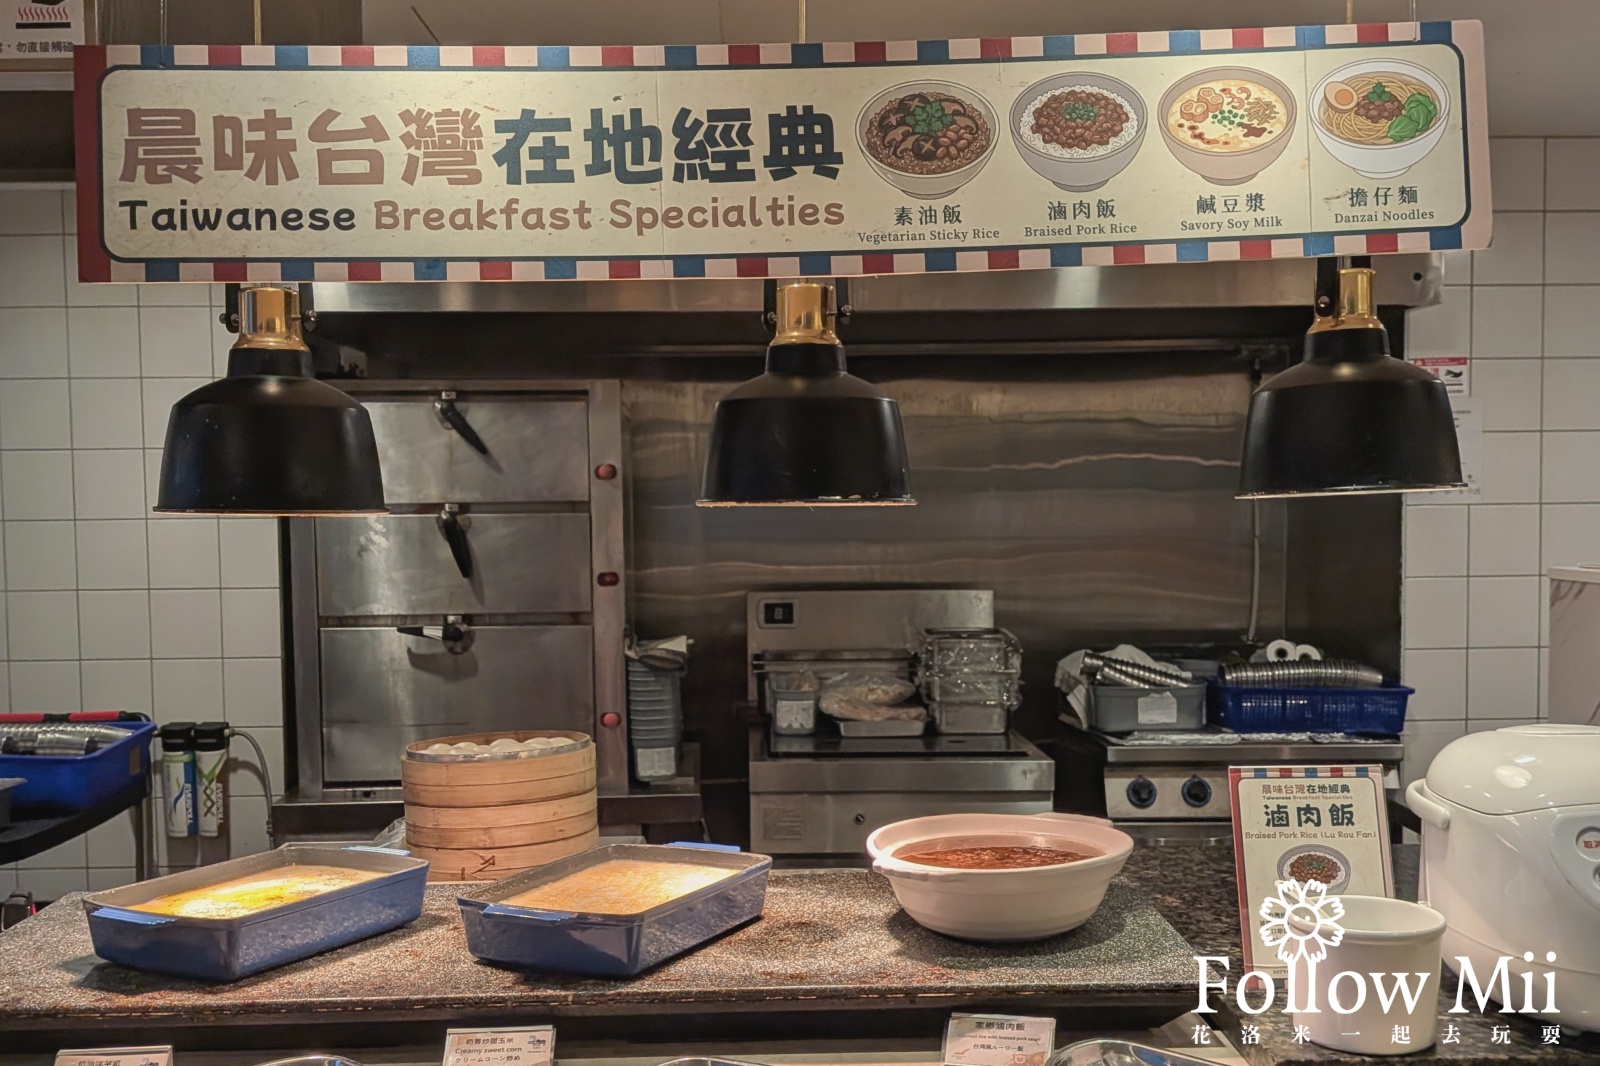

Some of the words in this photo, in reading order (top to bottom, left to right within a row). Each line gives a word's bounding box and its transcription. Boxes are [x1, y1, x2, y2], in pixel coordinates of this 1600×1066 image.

[118, 105, 844, 186] 晨味台灣在地經典
[1196, 193, 1266, 215] 鹹豆漿
[1348, 185, 1419, 208] 擔仔麵
[118, 199, 357, 231] Taiwanese
[374, 197, 592, 231] Breakfast
[608, 195, 845, 236] Specialties
[893, 204, 963, 226] 素油飯
[1047, 198, 1117, 221] 滷肉飯
[1334, 210, 1379, 224] Danzai
[1382, 208, 1435, 222] Noodles
[1024, 224, 1073, 238] Braised
[1076, 223, 1106, 236] Pork
[1109, 222, 1138, 234] Rice
[1180, 219, 1224, 233] Savory
[1227, 218, 1250, 231] Soy
[1253, 216, 1283, 228] Milk
[857, 230, 926, 245] Vegetarian
[929, 229, 969, 243] Sticky
[972, 228, 1000, 240] Rice
[1263, 804, 1355, 828] 滷肉飯
[1245, 831, 1277, 839] Braised
[1279, 831, 1298, 839] Pork
[1320, 831, 1335, 839] (Lu
[1356, 830, 1377, 838] Fan)
[455, 1047, 482, 1055] Creamy
[484, 1046, 505, 1054] sweet
